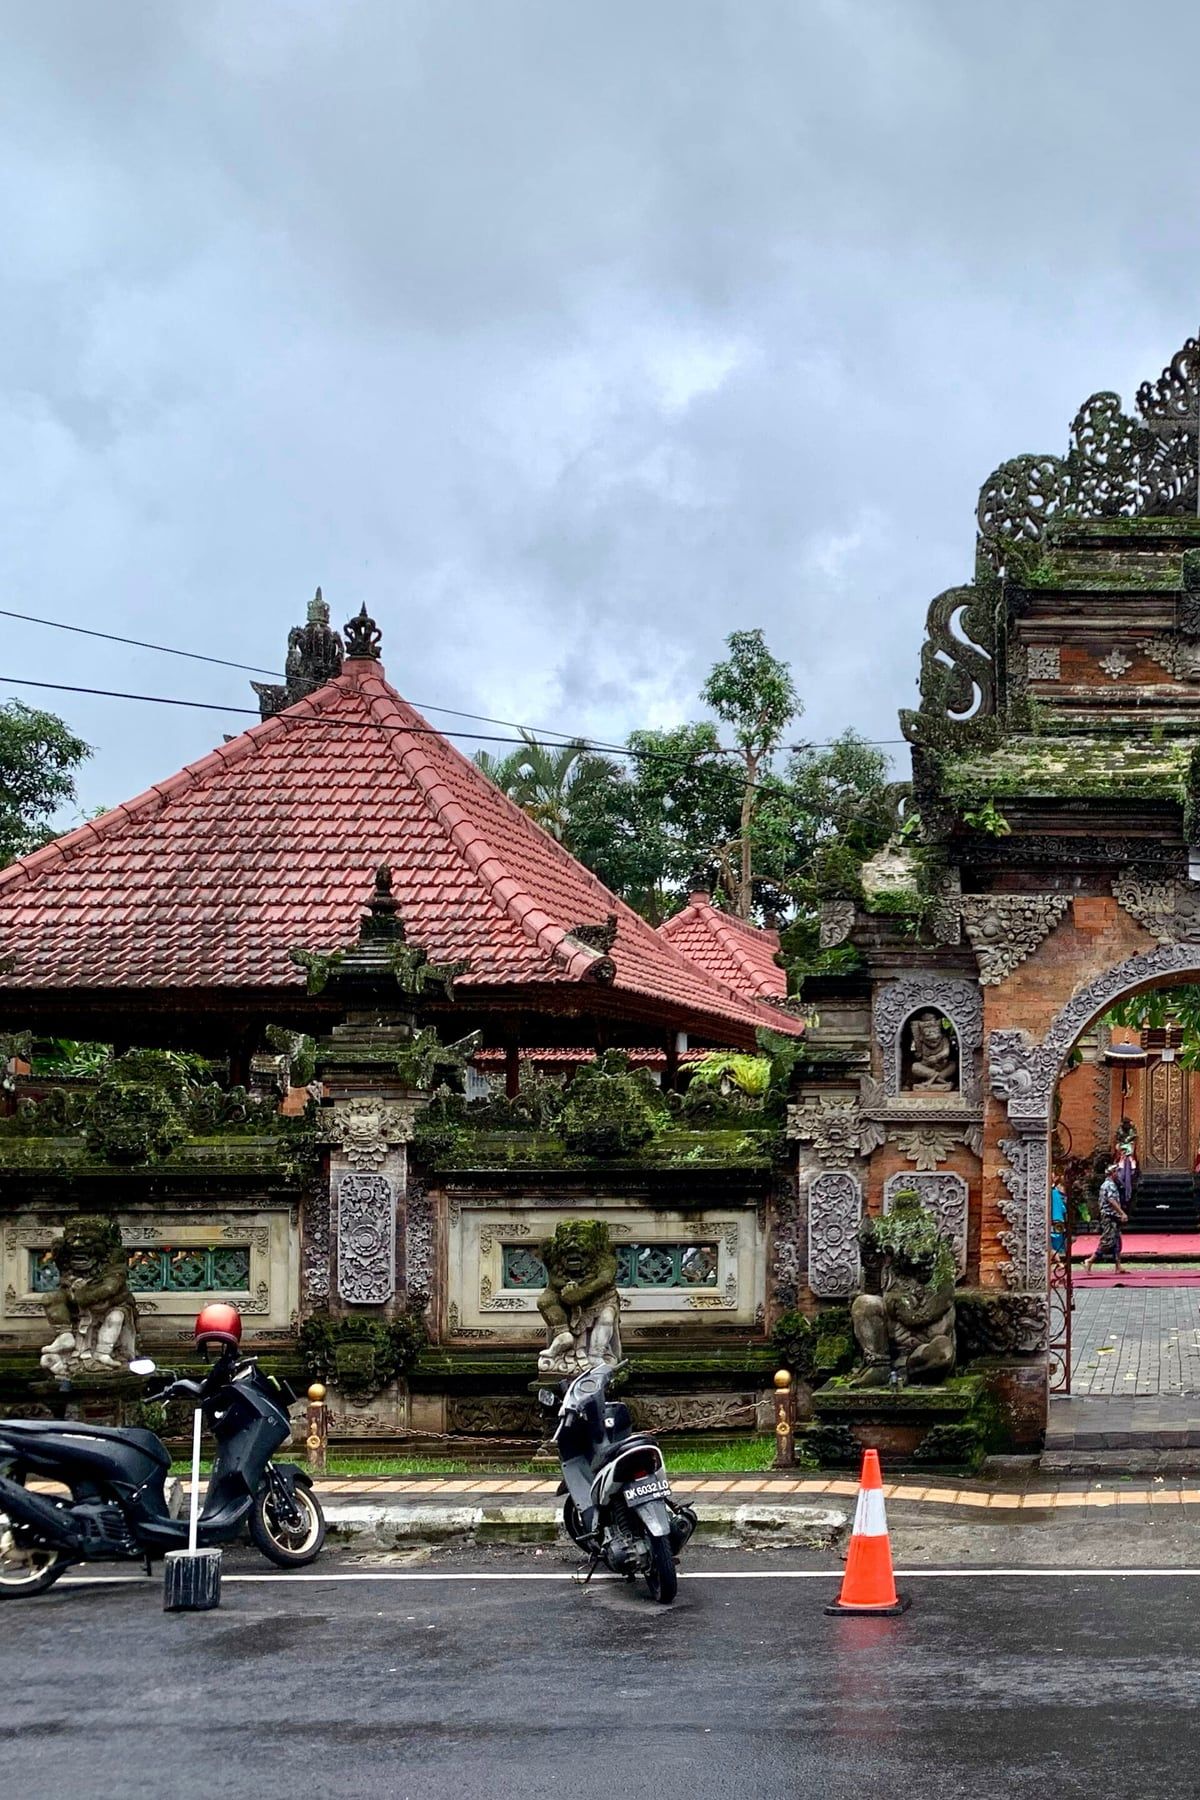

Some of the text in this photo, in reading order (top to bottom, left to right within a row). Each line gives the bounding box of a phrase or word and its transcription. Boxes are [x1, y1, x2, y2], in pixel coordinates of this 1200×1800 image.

[626, 1480, 669, 1499] DK 6032 LO
